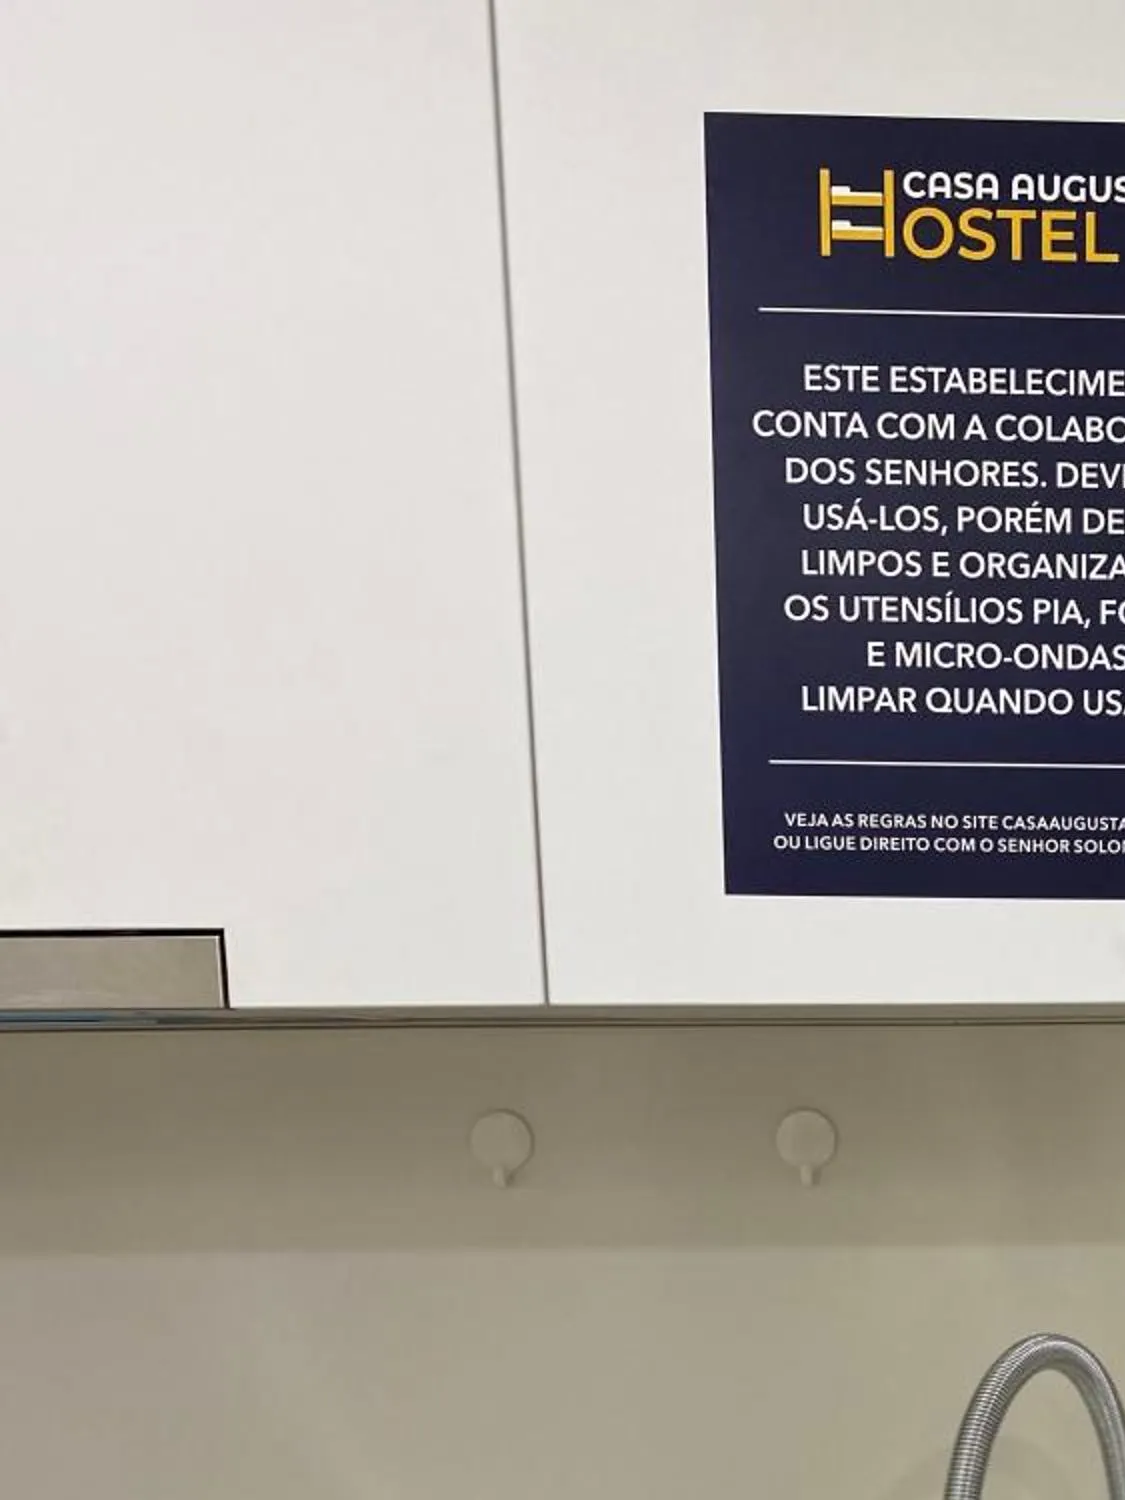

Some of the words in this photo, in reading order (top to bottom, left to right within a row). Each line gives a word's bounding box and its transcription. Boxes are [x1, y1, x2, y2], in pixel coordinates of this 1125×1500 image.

[902, 170, 999, 200] CASA
[803, 363, 880, 393] ESTE
[752, 409, 869, 439] CONTA
[876, 411, 955, 441] COM
[963, 413, 988, 441] A
[785, 457, 856, 485] DOS
[864, 458, 1047, 489] SENHORES.
[803, 497, 948, 537] USÁ-LOS,
[957, 500, 1072, 534] PORÉM
[801, 549, 923, 578] LIMPOS
[931, 551, 951, 578] E
[783, 594, 830, 622] OS
[839, 590, 1024, 626] UTENSÍLIOS
[1033, 598, 1091, 629] PIA,
[867, 641, 886, 668] E
[801, 685, 917, 713] LIMPAR
[925, 686, 1074, 717] QUANDO
[784, 812, 829, 828] VEJA
[831, 813, 854, 828] AS
[857, 813, 927, 829] REGRAS
[931, 814, 959, 830] NO
[962, 814, 999, 830] SITE
[773, 835, 801, 850] OU
[804, 835, 856, 851] LIGUE
[859, 836, 931, 851] DIREITO
[933, 837, 976, 852] COM
[979, 837, 994, 853] O
[997, 838, 1070, 853] SENHOR
